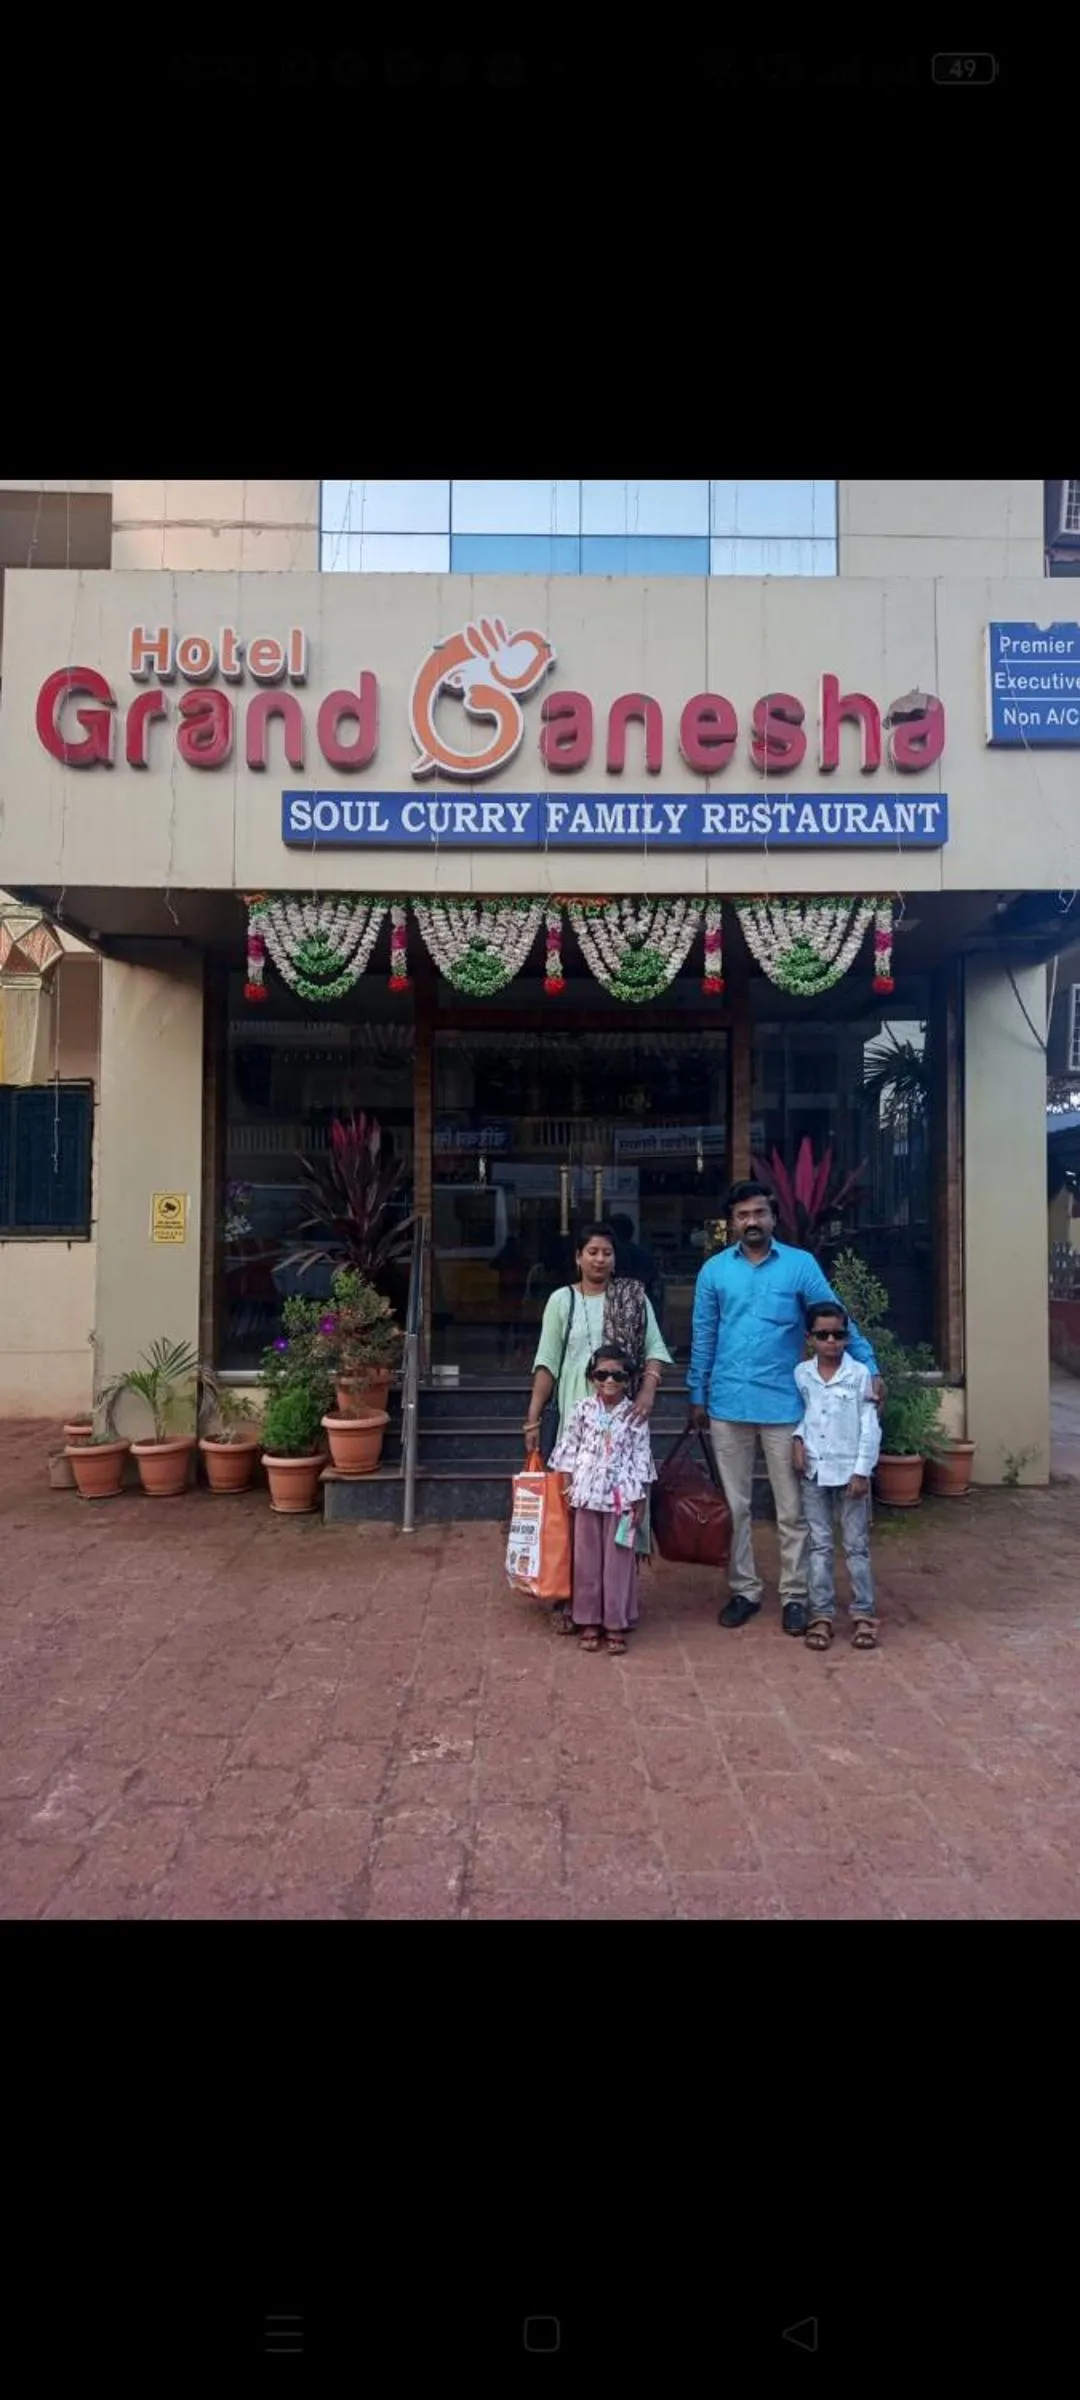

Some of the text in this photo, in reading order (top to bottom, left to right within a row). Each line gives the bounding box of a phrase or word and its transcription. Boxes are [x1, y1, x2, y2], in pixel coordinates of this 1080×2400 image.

[129, 625, 308, 682] Hotel
[1000, 636, 1075, 654] Premier
[35, 665, 380, 771] Grand
[1003, 707, 1079, 726] Non A/C
[290, 799, 941, 834] SOUL CURRY FAMILY RESTAURANT
